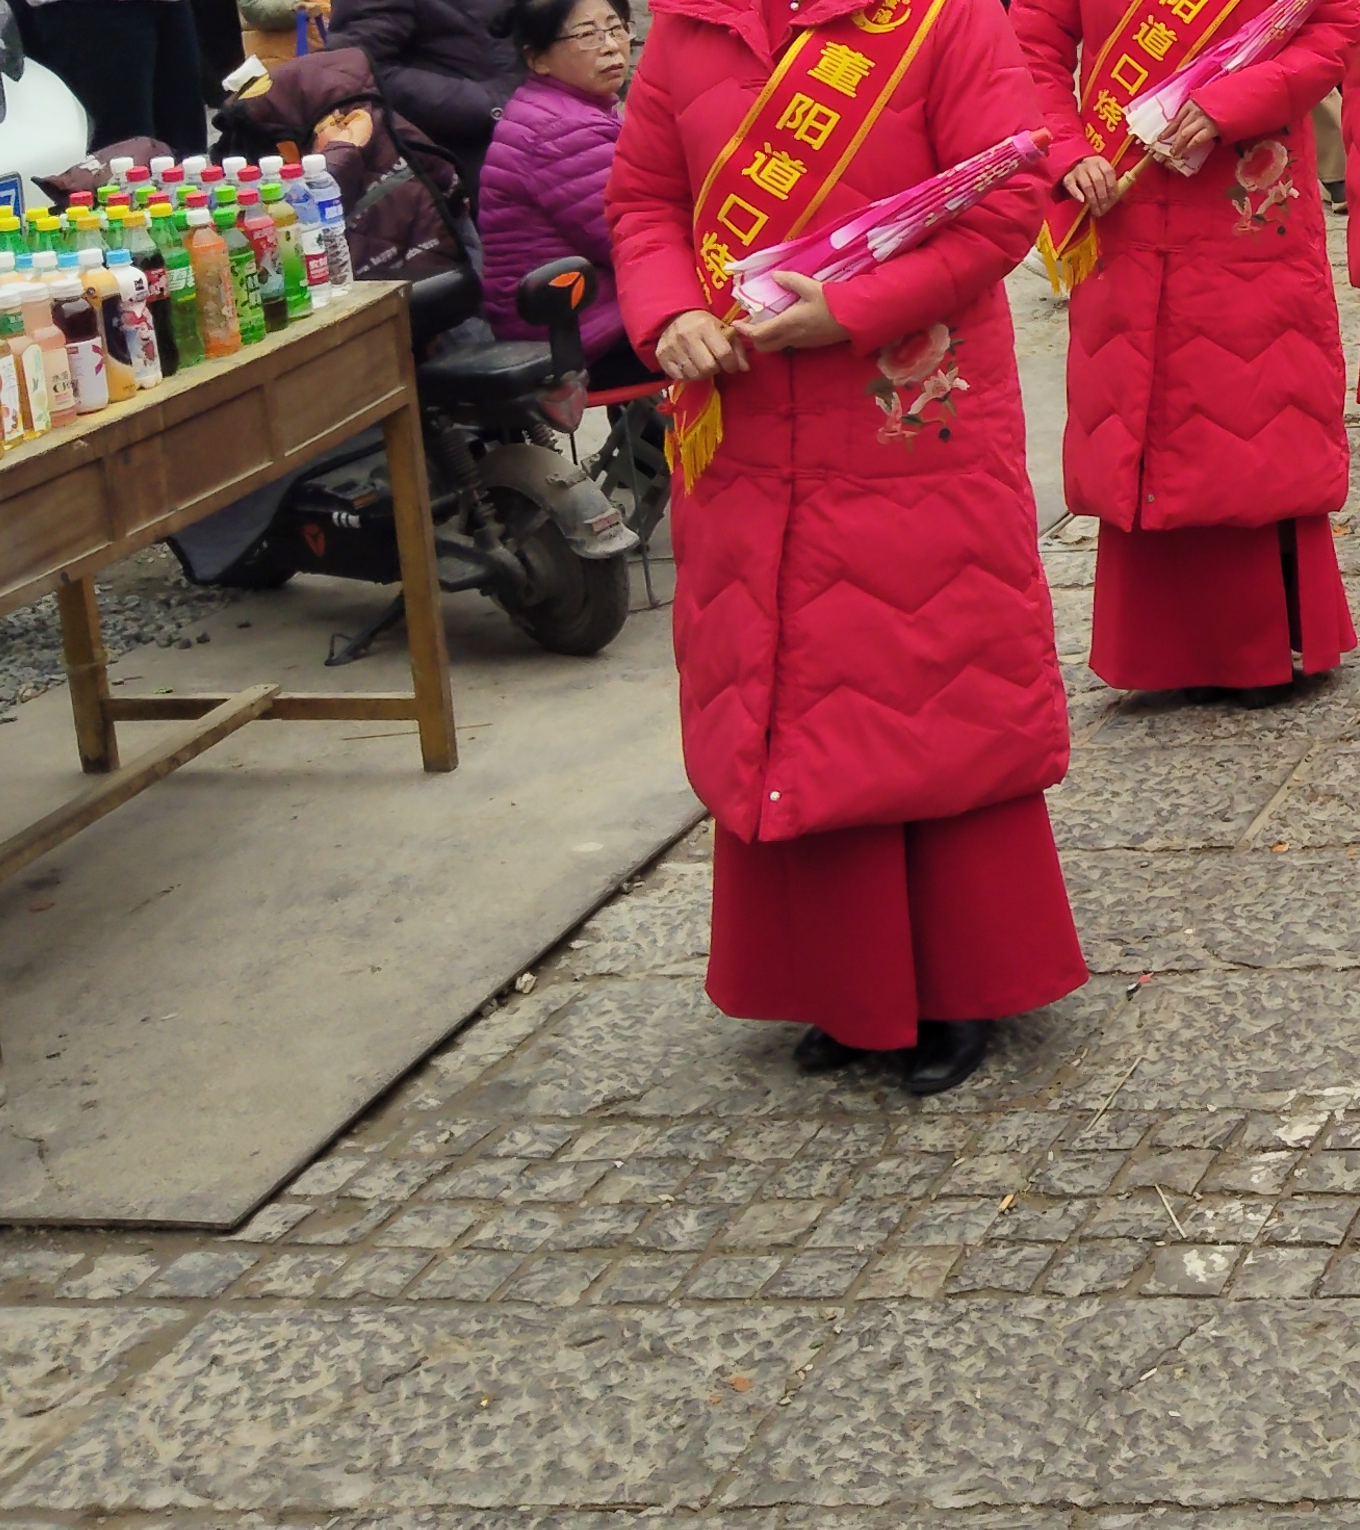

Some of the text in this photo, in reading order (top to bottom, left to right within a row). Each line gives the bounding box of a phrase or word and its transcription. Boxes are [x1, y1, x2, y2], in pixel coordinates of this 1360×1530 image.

[695, 40, 876, 306] 董阳道口烧
